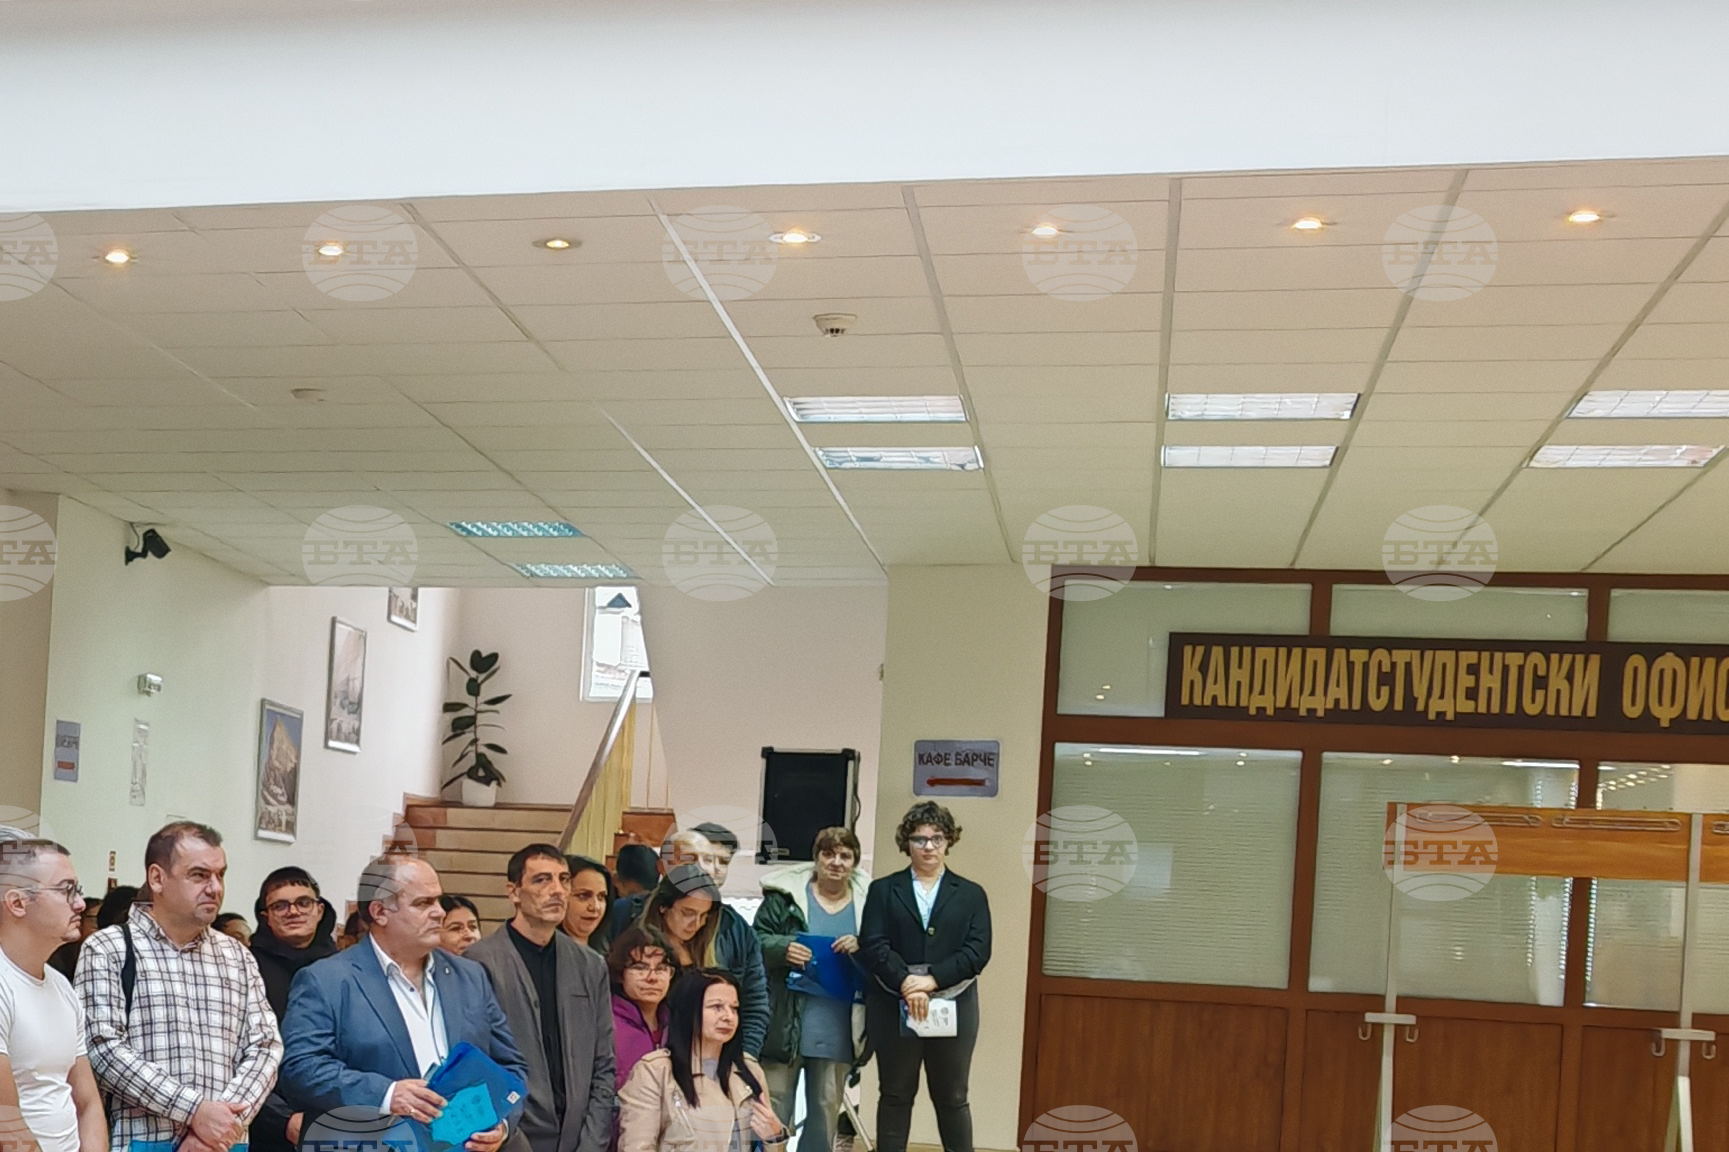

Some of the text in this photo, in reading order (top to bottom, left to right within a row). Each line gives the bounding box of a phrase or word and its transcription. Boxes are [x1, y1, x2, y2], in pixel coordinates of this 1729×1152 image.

[1181, 644, 1729, 728] КАНДИДАТСТУДЕНТСКИ ОФИС
[918, 751, 996, 767] КАФЕ БАРЧЕ
